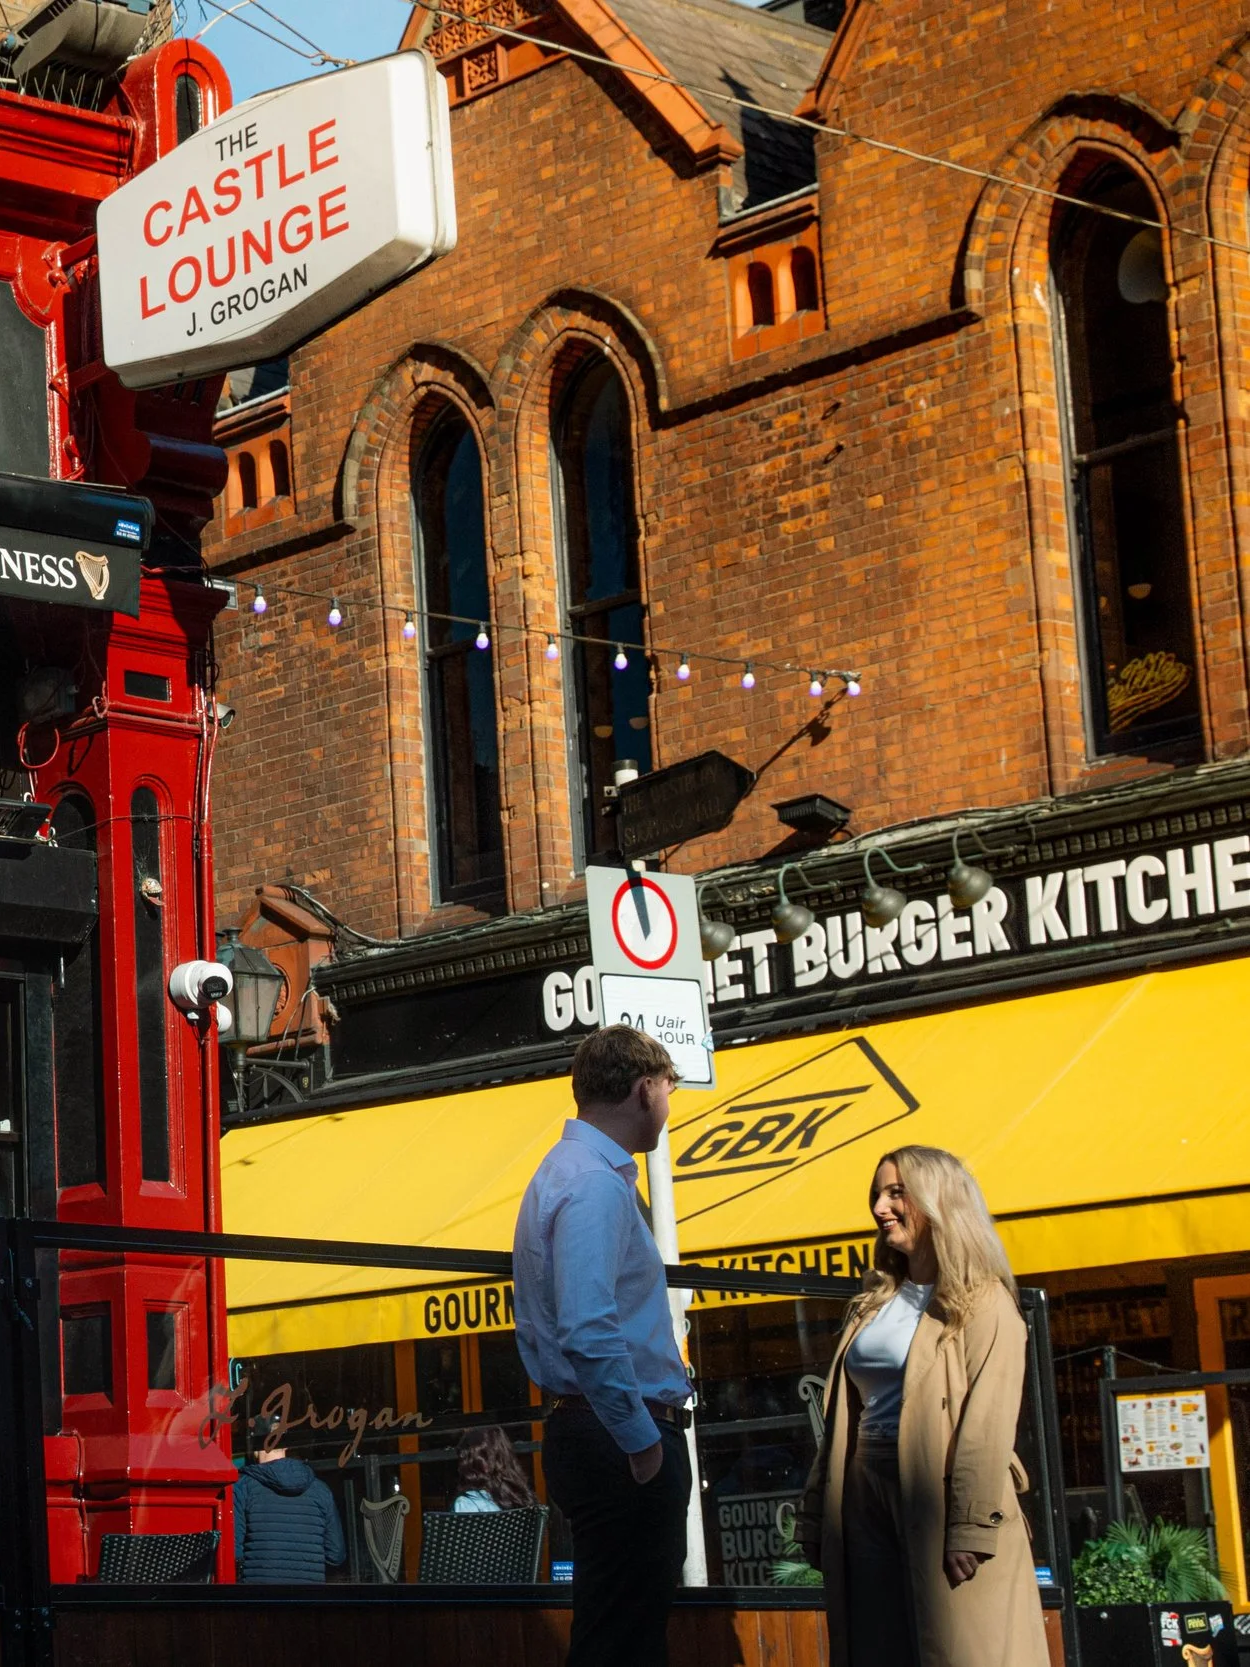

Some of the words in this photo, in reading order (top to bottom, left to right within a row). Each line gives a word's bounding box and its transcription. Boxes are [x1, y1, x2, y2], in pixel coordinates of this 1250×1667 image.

[214, 122, 259, 162] THE
[142, 118, 340, 248] CASTLE
[138, 184, 350, 320] LOUNGE
[186, 312, 204, 337] J.
[209, 263, 309, 326] GROGAN
[542, 928, 778, 1032] GOET
[791, 885, 1011, 988] BURGER
[655, 1015, 687, 1030] Uair
[675, 1100, 857, 1167] GBK
